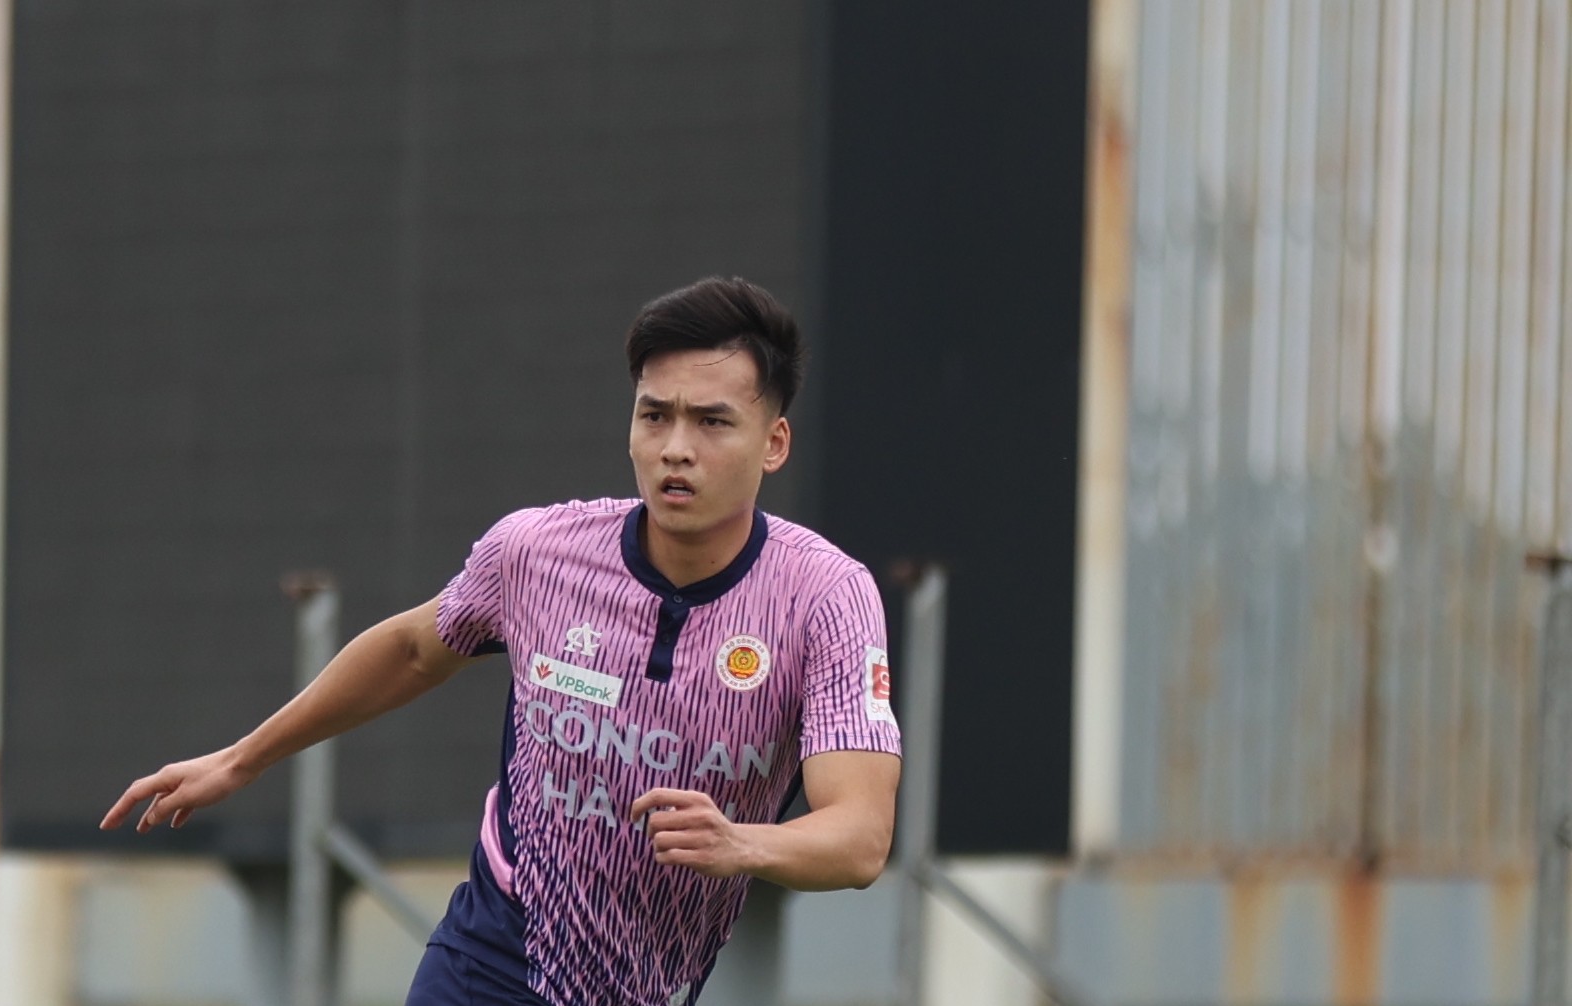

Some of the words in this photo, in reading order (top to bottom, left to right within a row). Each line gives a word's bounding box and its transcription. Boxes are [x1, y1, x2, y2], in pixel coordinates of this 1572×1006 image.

[556, 672, 612, 701] VPBank
[526, 699, 679, 772] CÔNG
[693, 741, 776, 781] AN
[542, 771, 618, 828] HÀ
